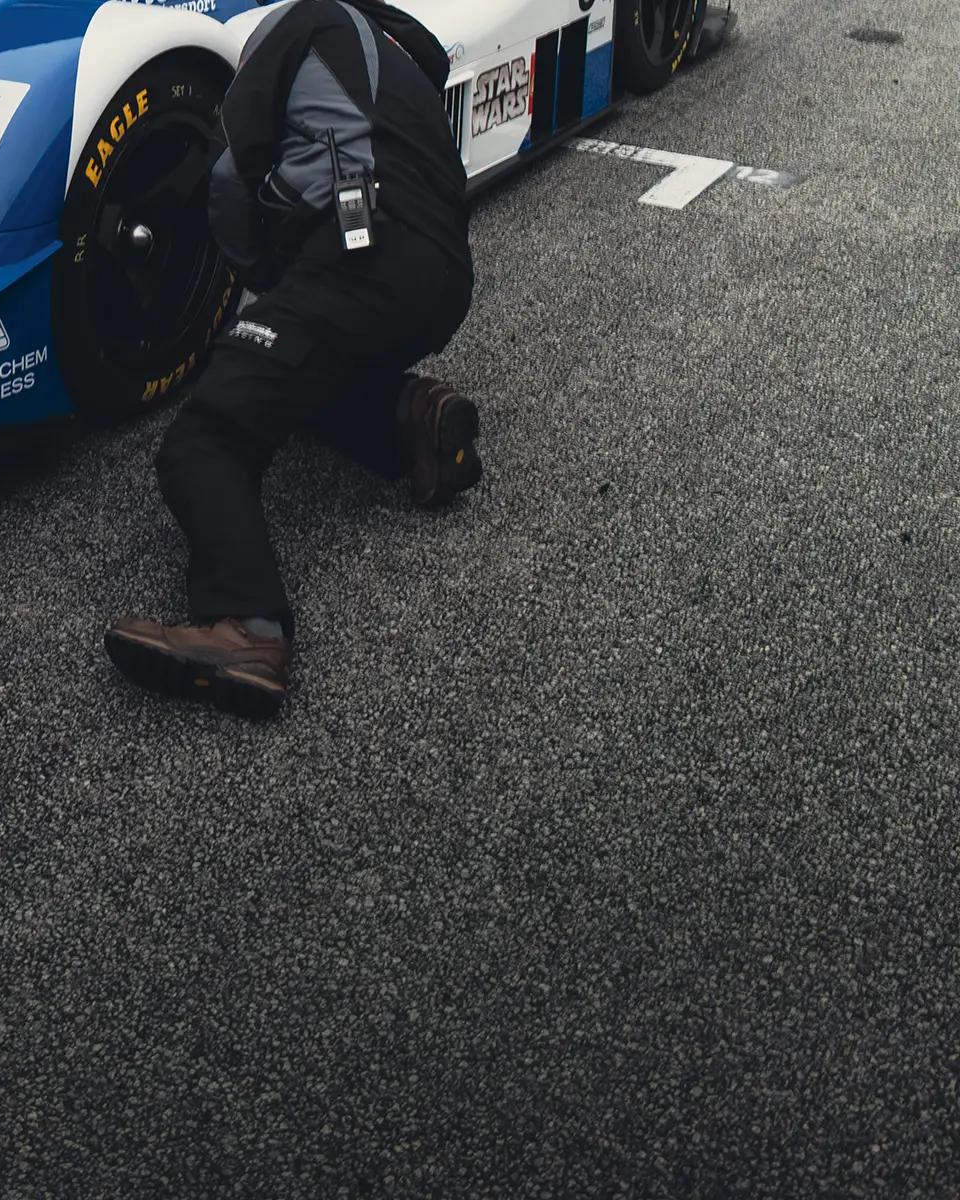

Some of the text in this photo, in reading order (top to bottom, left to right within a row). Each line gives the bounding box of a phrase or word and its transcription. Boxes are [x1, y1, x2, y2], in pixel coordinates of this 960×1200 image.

[473, 56, 529, 104] STAR
[85, 87, 149, 188] EAGLE
[471, 84, 529, 138] WARS
